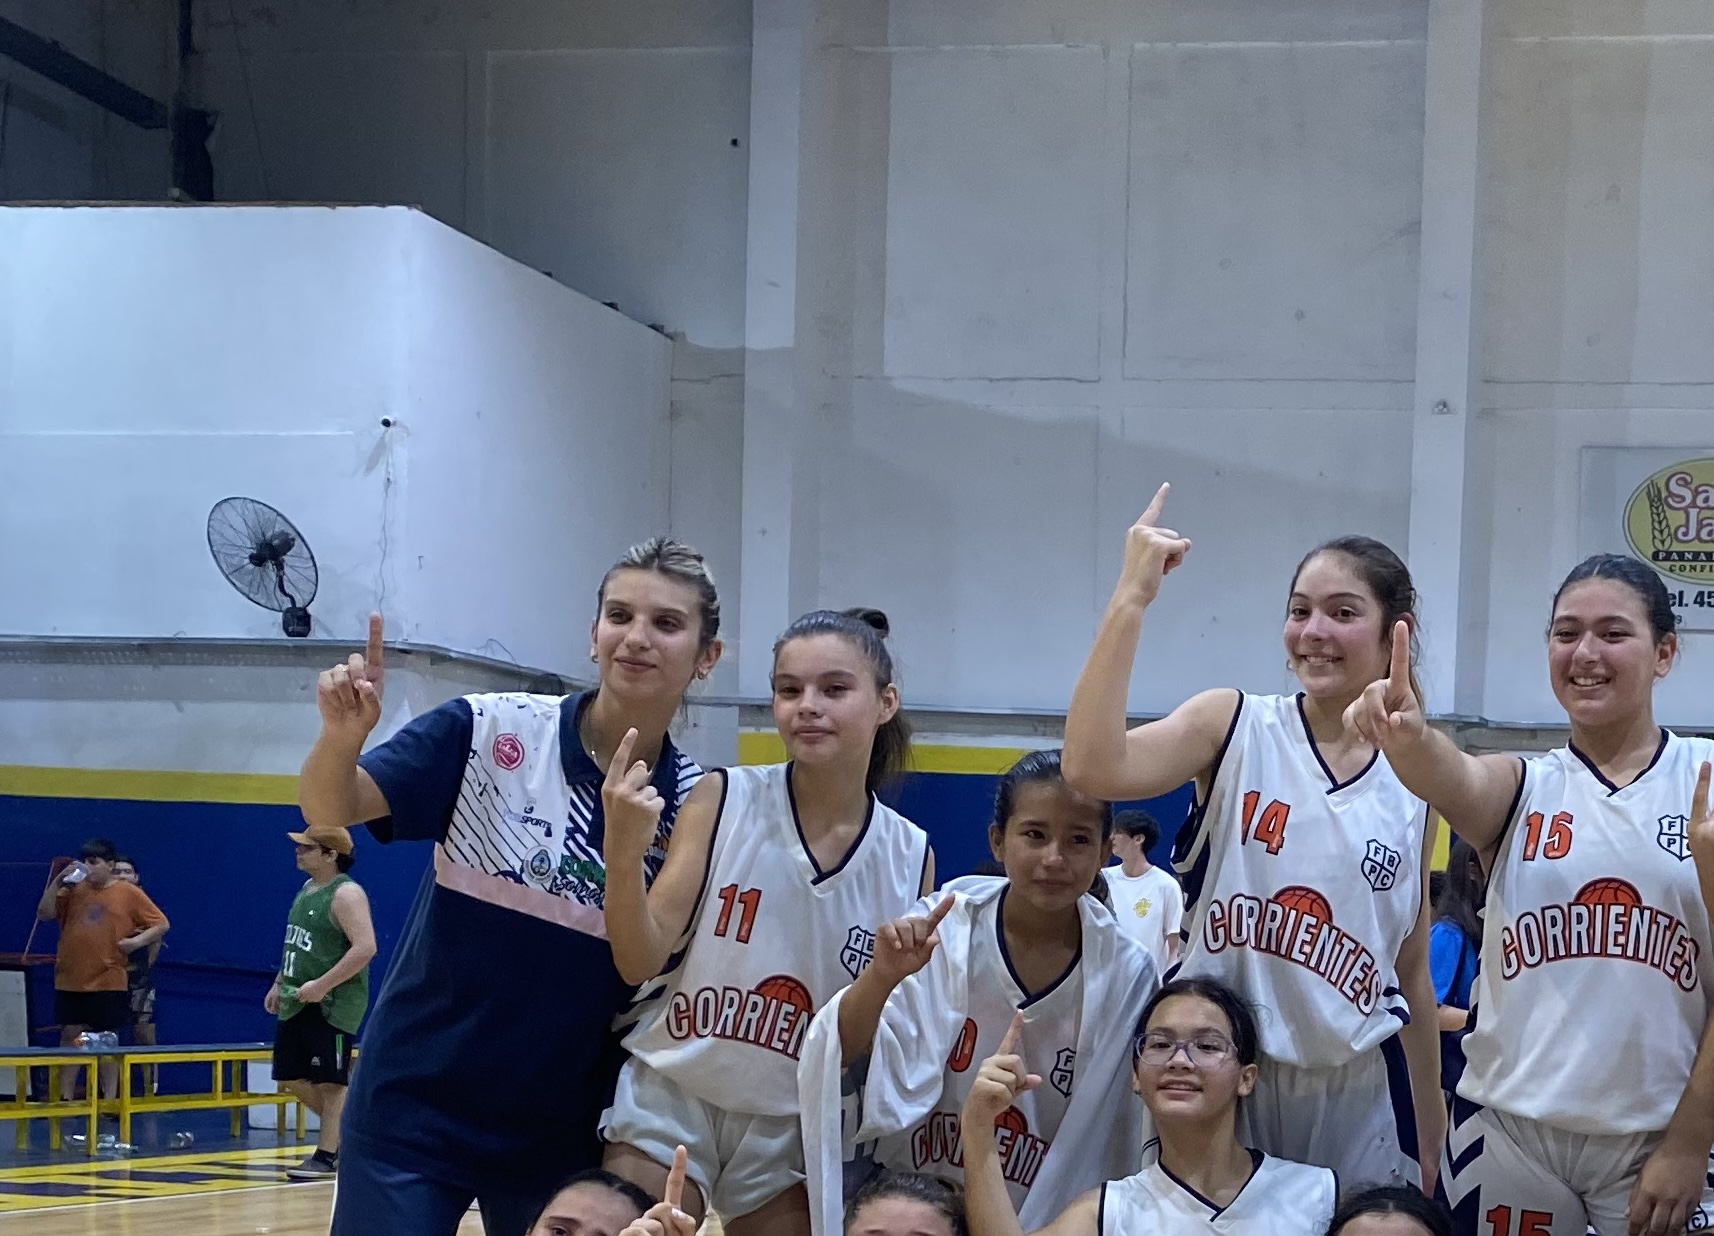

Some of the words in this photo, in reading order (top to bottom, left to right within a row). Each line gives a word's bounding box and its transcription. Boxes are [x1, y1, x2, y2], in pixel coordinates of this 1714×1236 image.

[1241, 790, 1291, 855] 14
[1523, 810, 1573, 861] 15
[714, 883, 762, 944] 11
[1204, 892, 1383, 1017] CORRIENTES
[1501, 902, 1700, 992] CORRIENTES
